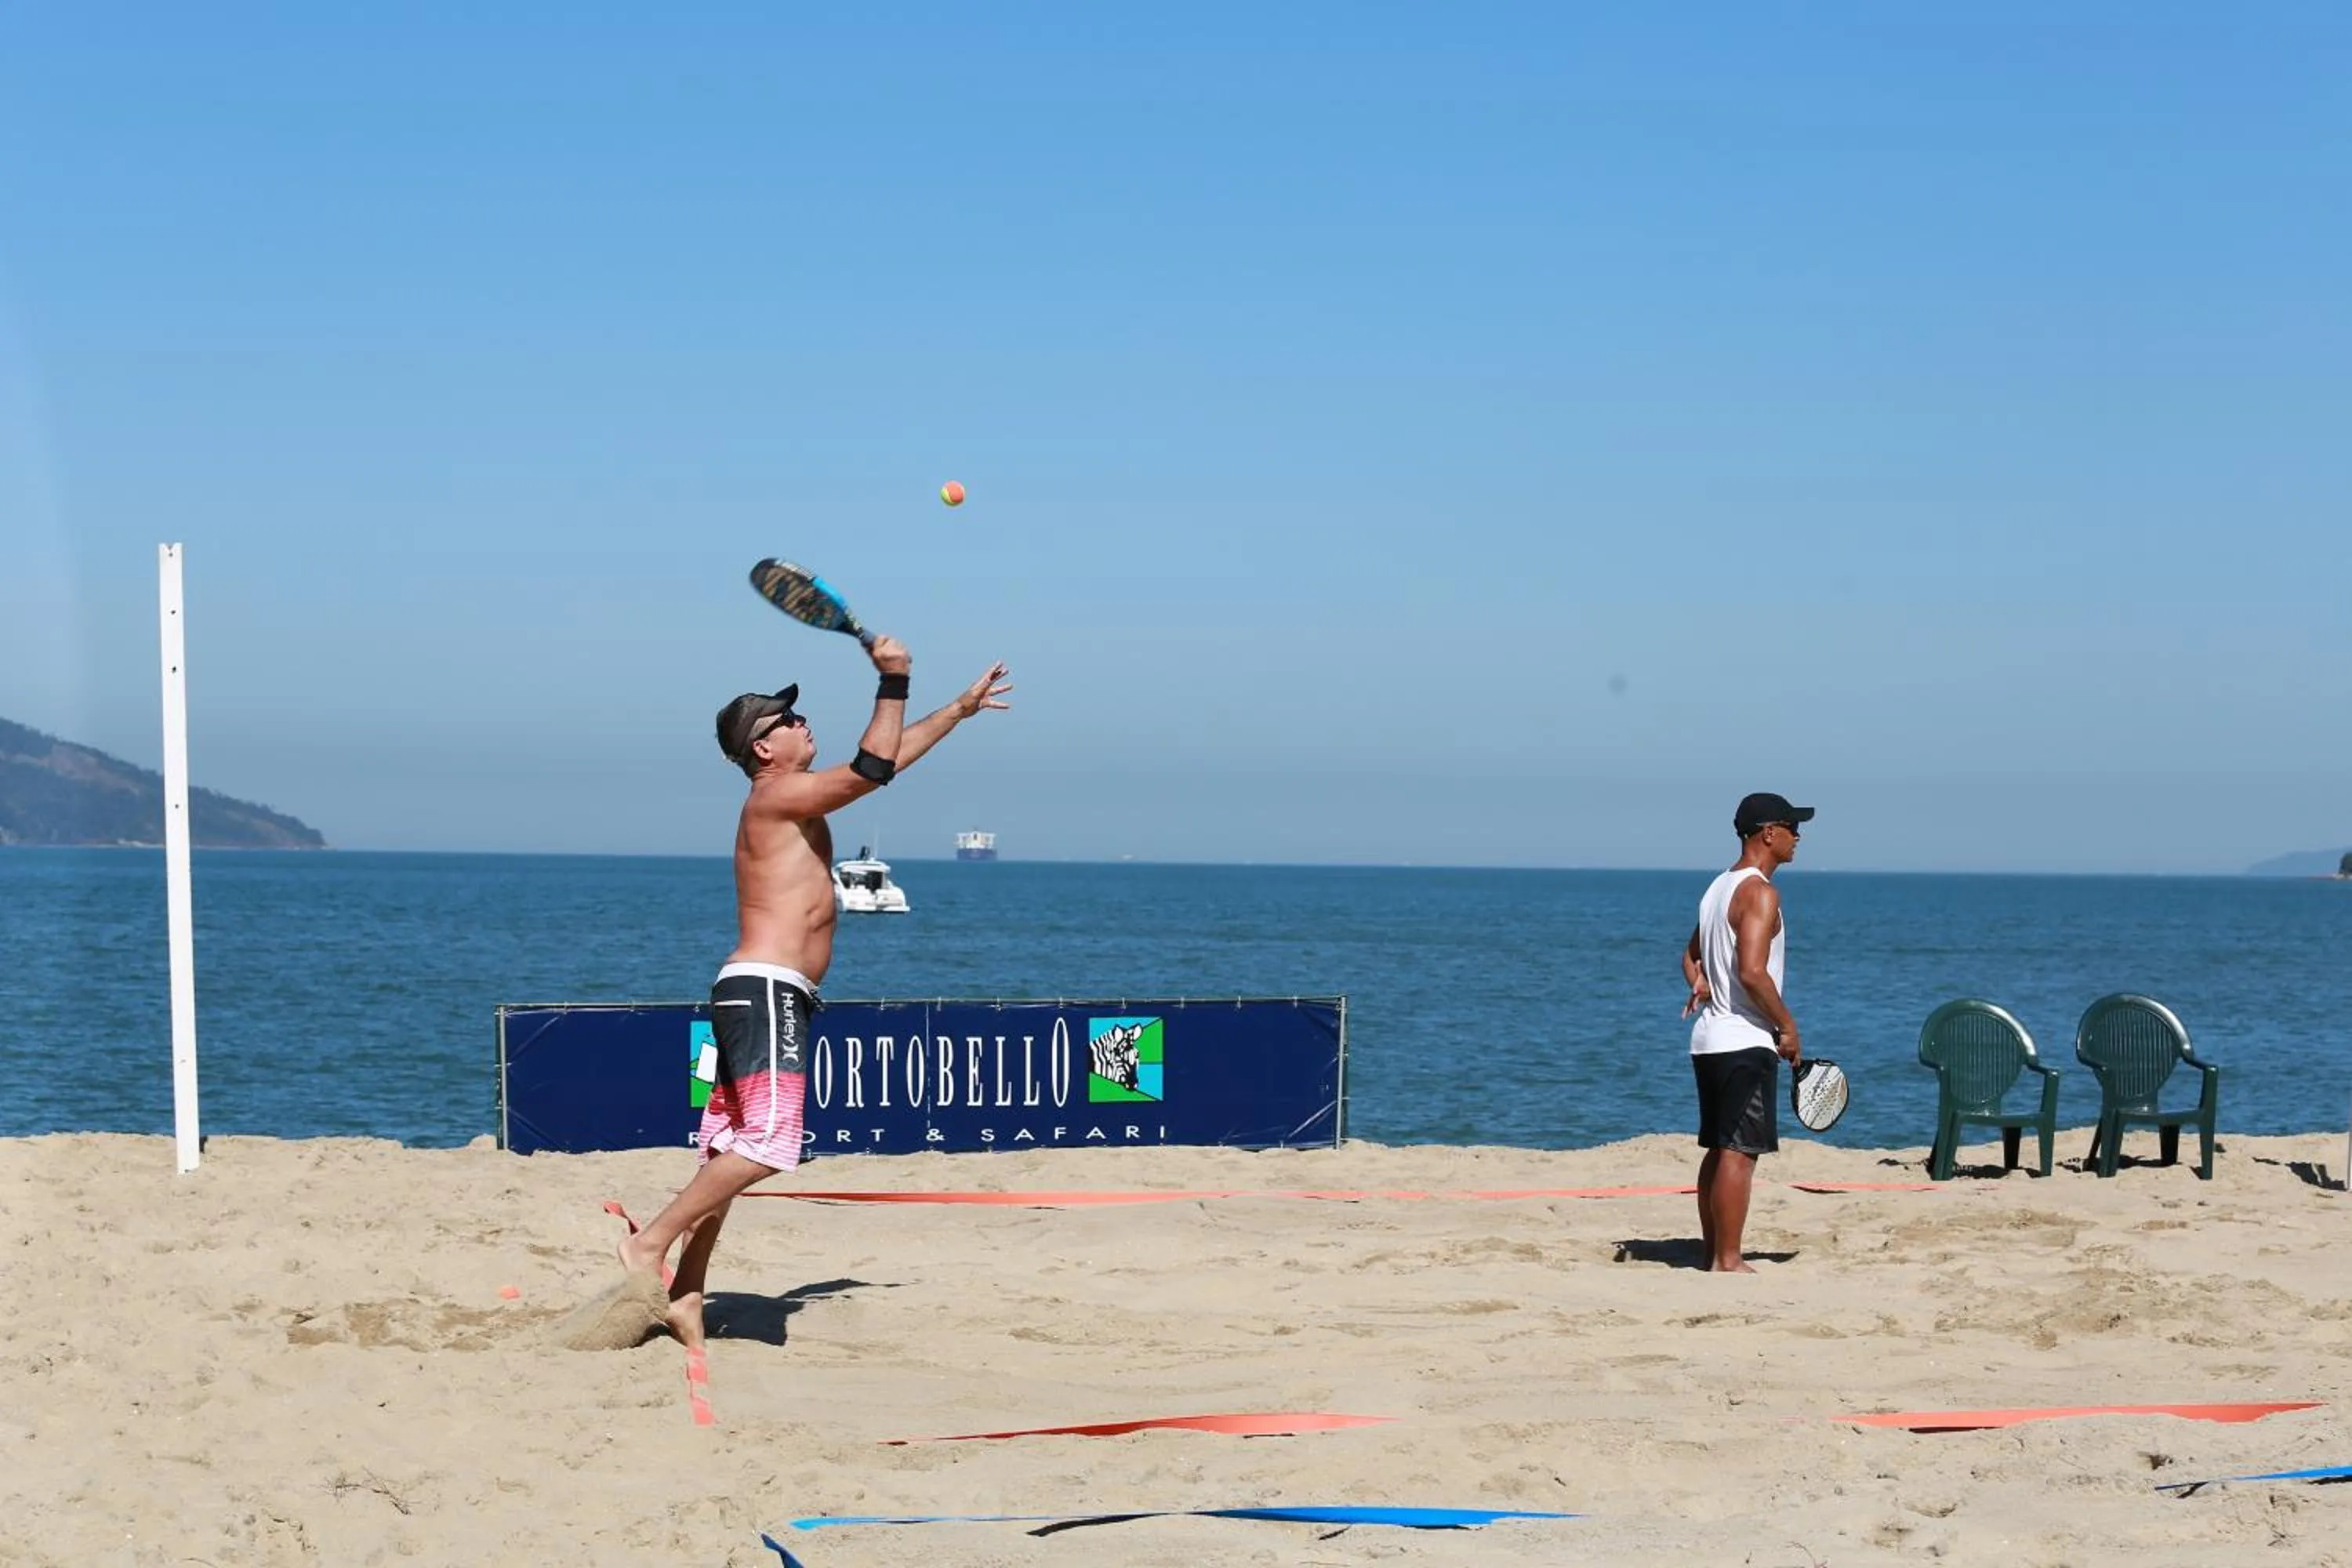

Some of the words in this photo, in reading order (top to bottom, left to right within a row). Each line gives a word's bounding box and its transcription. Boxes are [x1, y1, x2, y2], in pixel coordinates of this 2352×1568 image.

[781, 993, 797, 1044] Hurley
[814, 1017, 1071, 1109] ORTOBELLO
[688, 1128, 885, 1145] RORT
[926, 1129, 945, 1142] &
[980, 1125, 1165, 1142] SAFARI
